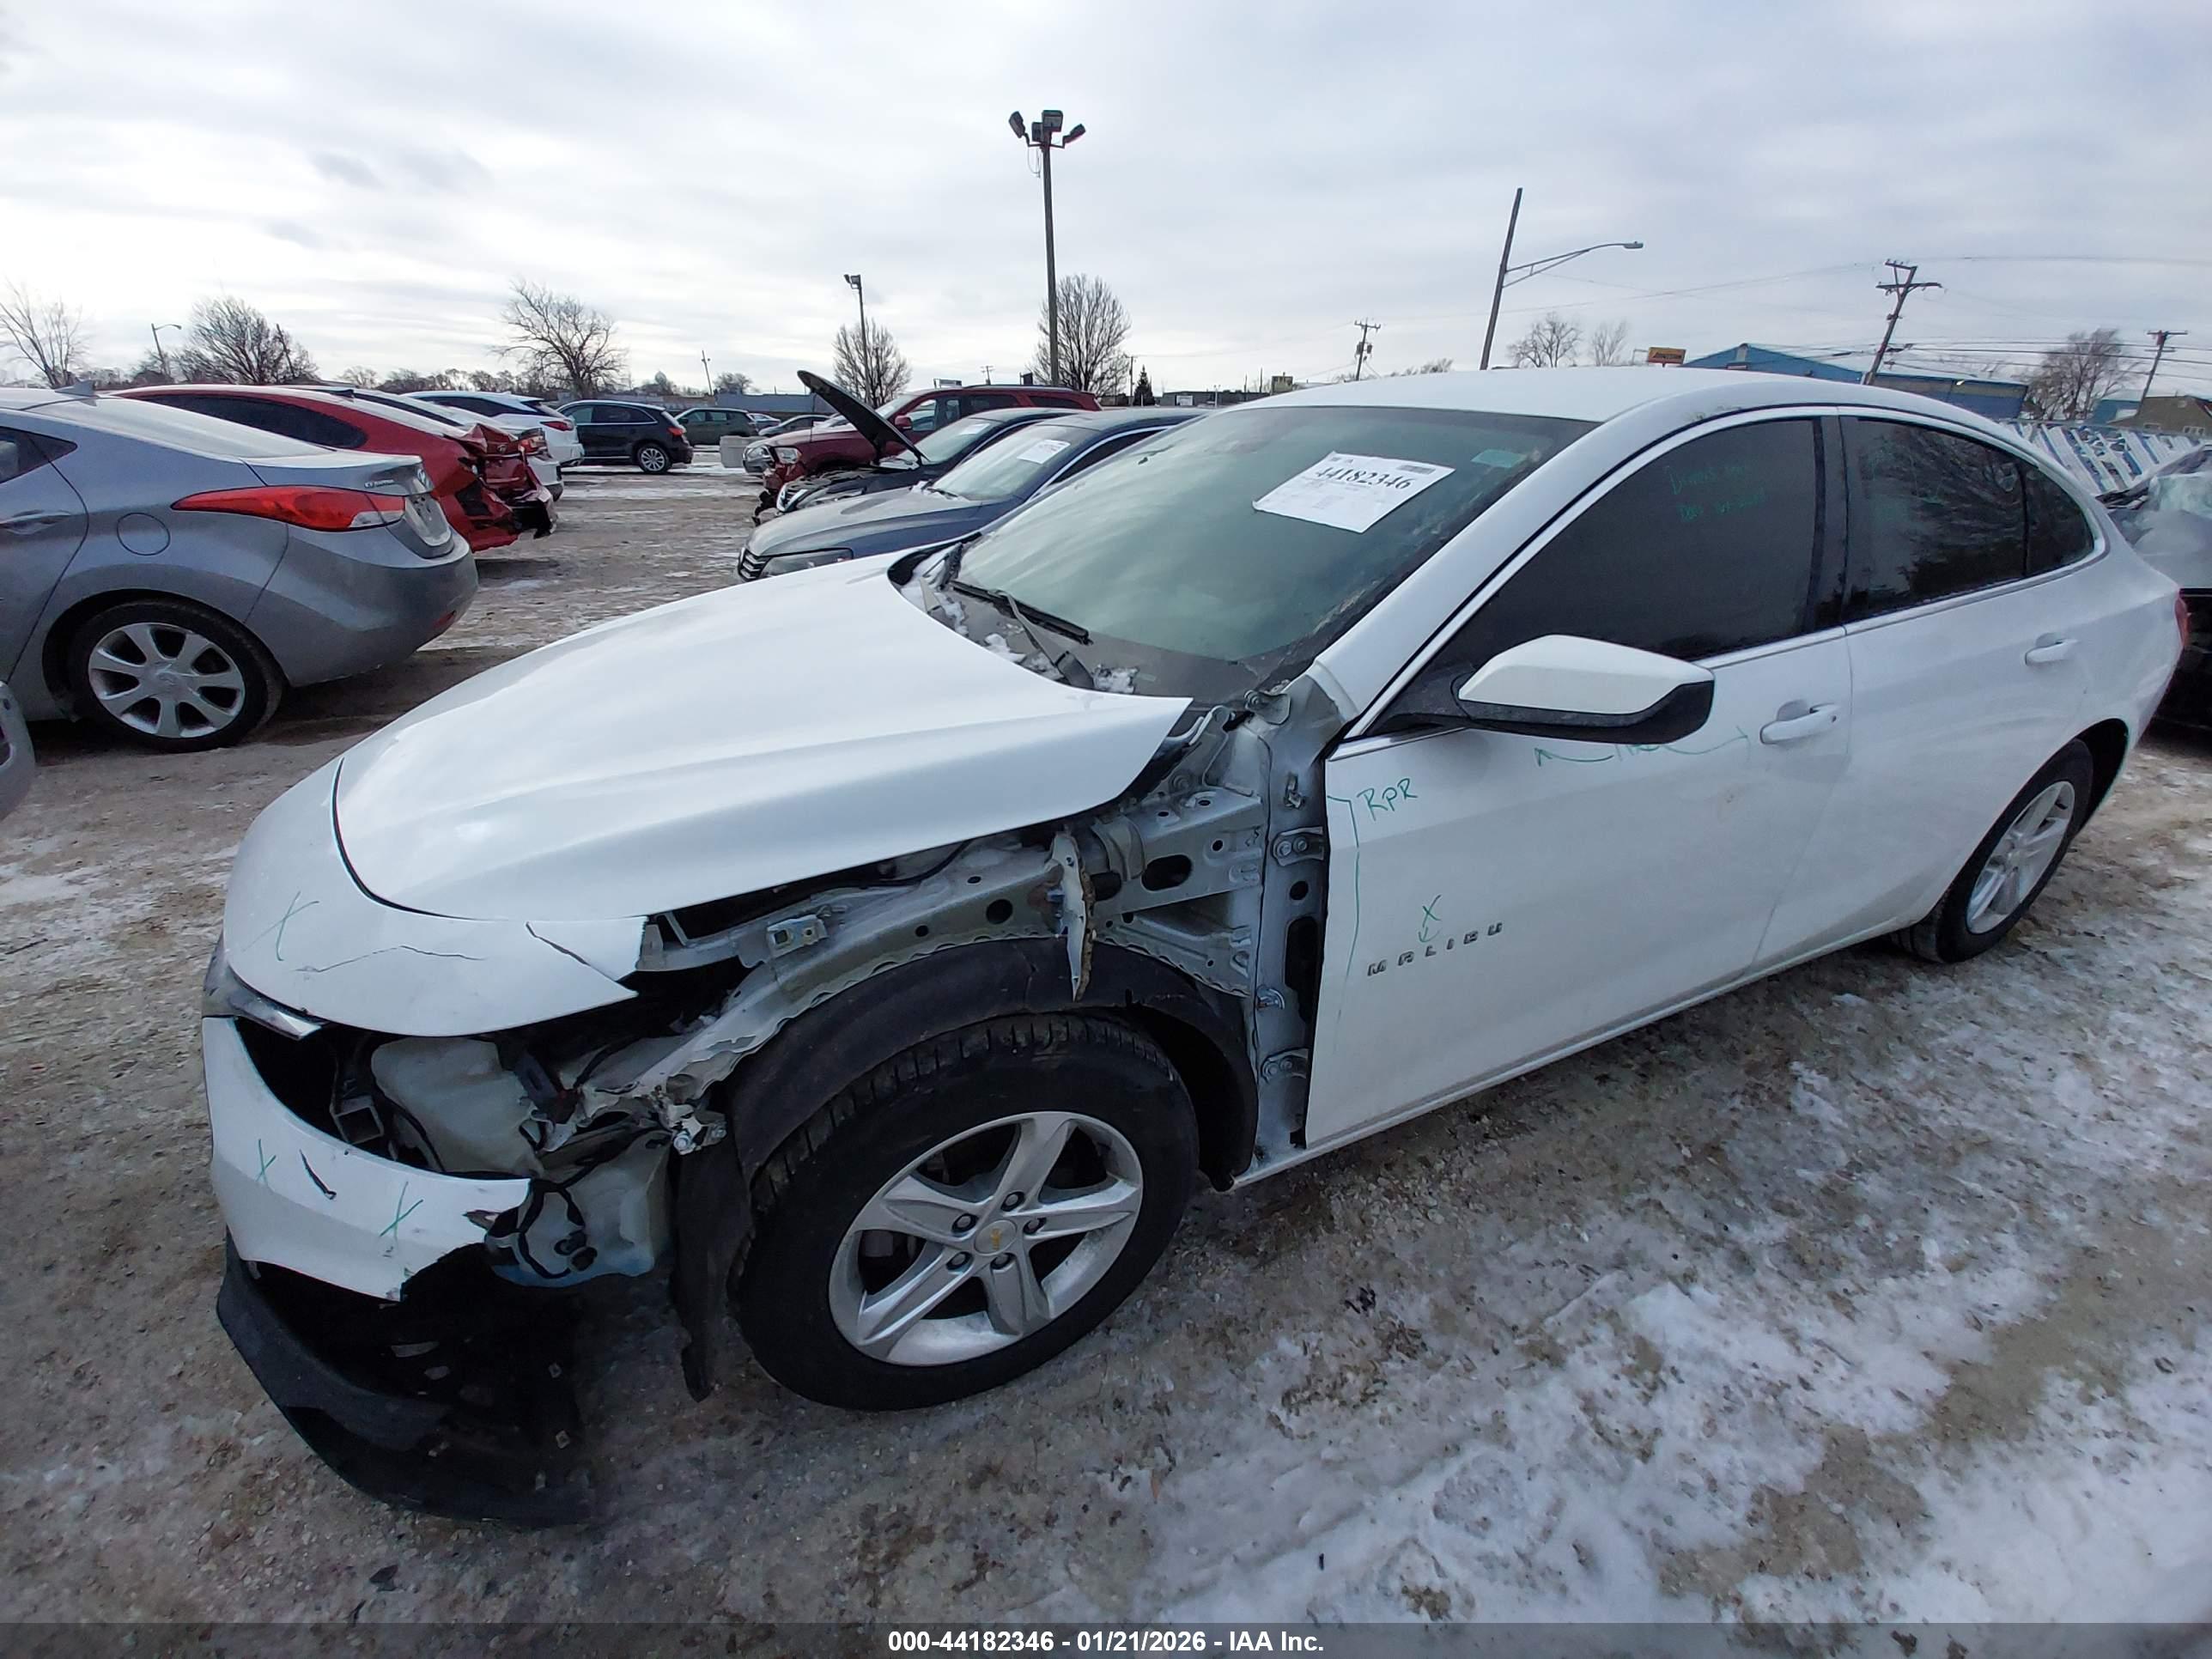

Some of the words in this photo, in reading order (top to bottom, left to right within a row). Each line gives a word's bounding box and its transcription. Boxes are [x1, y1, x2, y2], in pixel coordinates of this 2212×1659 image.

[1315, 466, 1416, 489] 44182346
[1355, 777, 1419, 822] RPR
[1367, 922, 1503, 976] MALIBU
